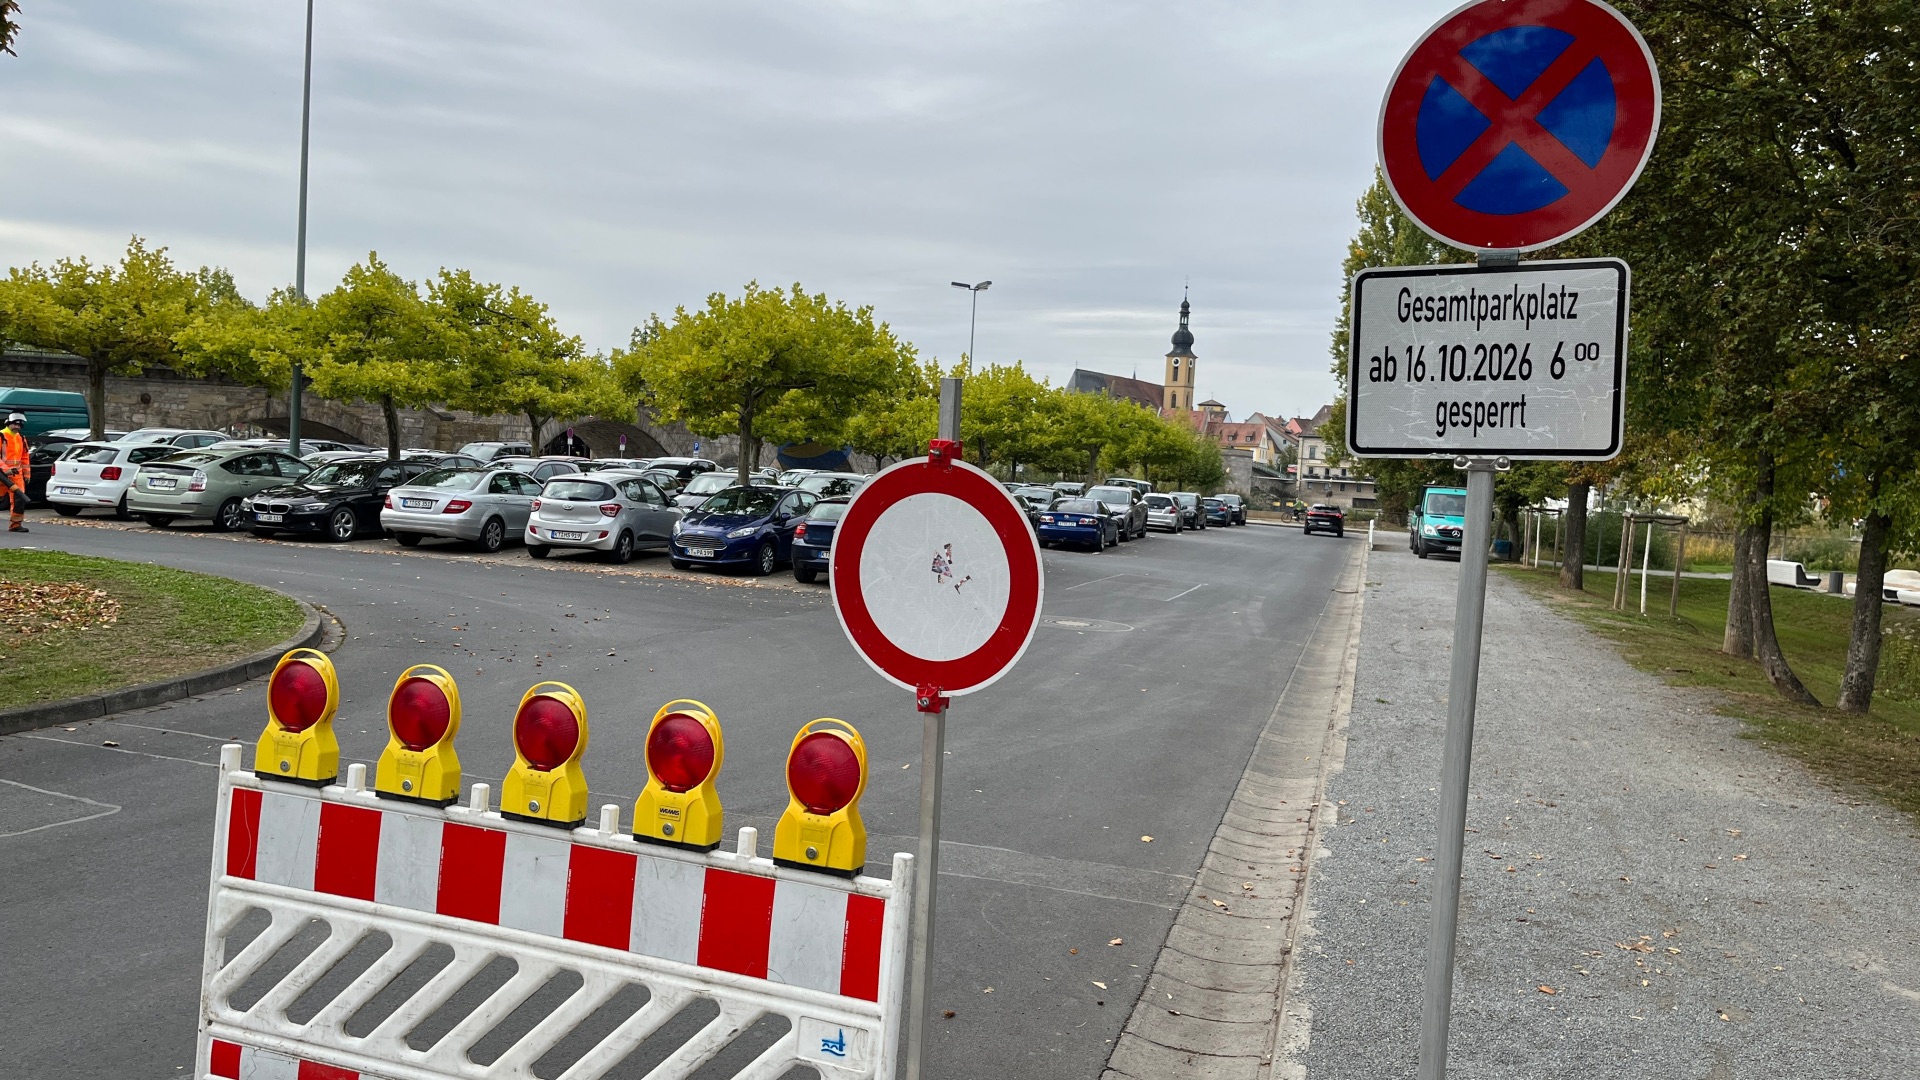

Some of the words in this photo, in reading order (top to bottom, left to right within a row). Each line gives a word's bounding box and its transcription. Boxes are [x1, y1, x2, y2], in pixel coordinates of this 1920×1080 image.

[1397, 283, 1579, 332] Gesamtparkplatz
[1369, 346, 1397, 382] ab
[1405, 343, 1533, 382] 16.10.2026
[1435, 394, 1527, 438] gesperrt
